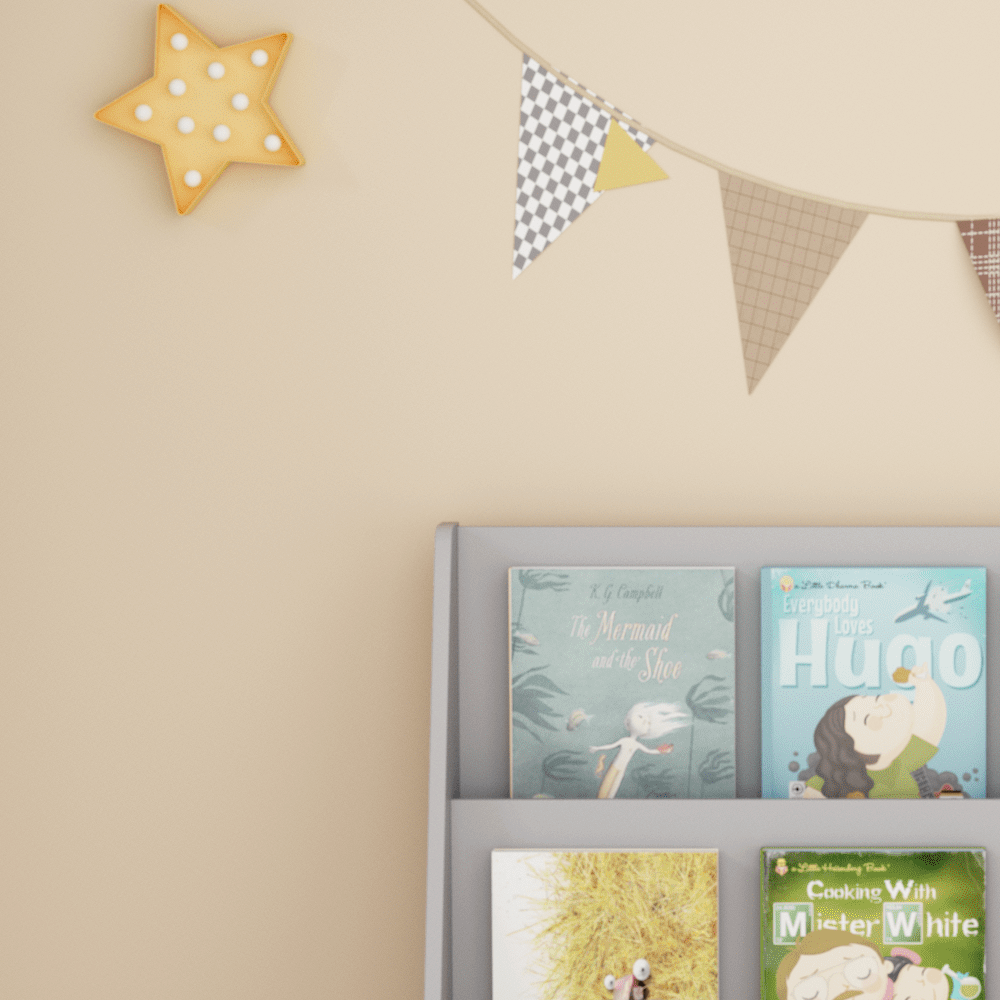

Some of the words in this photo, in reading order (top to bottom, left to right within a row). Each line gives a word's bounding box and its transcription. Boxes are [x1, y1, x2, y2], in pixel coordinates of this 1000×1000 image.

[617, 583, 664, 603] Campbell
[783, 594, 860, 618] Everybody
[570, 613, 592, 640] The
[589, 609, 679, 645] Mermaid
[834, 616, 874, 636] Loves
[592, 648, 618, 669] and
[618, 647, 638, 671] the
[638, 646, 683, 684] Shoe
[779, 617, 984, 705] Hugo
[806, 879, 883, 904] Cooking
[884, 879, 937, 900] With
[780, 911, 881, 938] Mister
[886, 910, 980, 938] White
